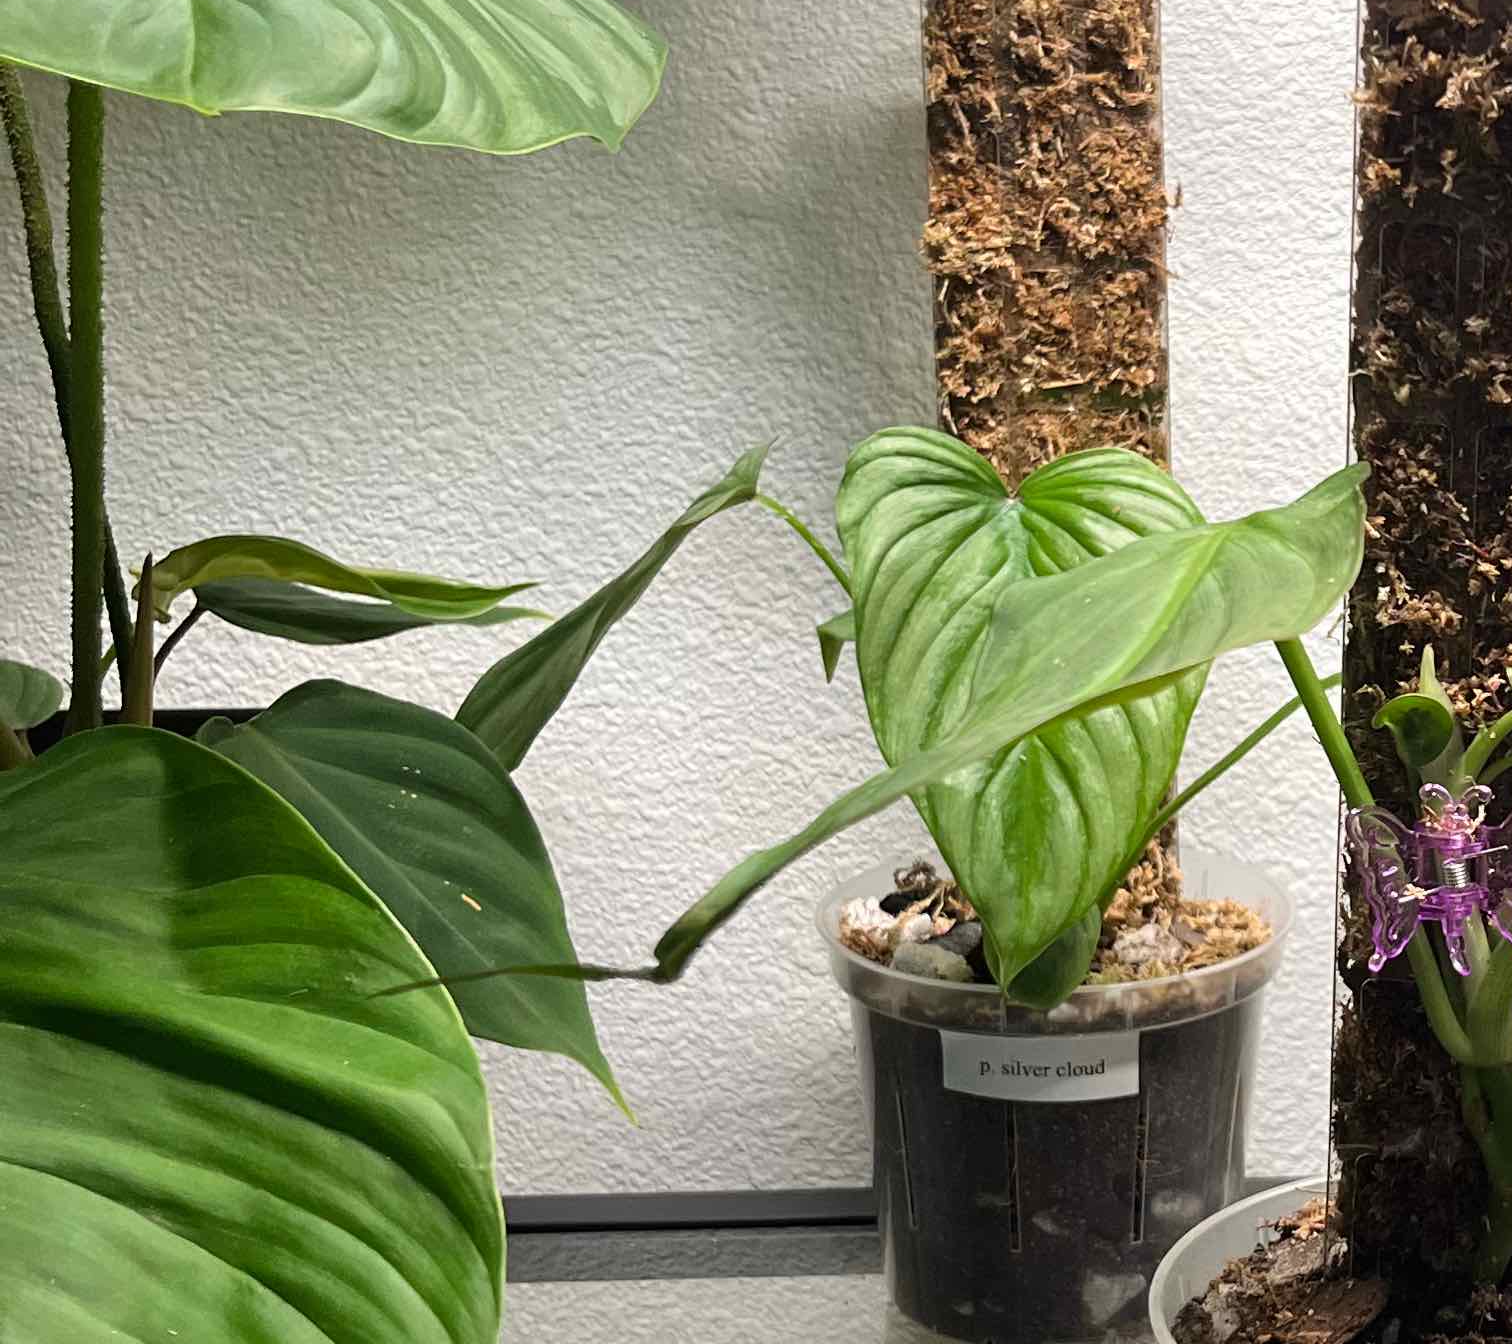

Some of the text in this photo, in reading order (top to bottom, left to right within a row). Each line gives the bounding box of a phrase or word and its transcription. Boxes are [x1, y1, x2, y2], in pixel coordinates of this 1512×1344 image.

[978, 1059, 1106, 1077] p. silver cloud
